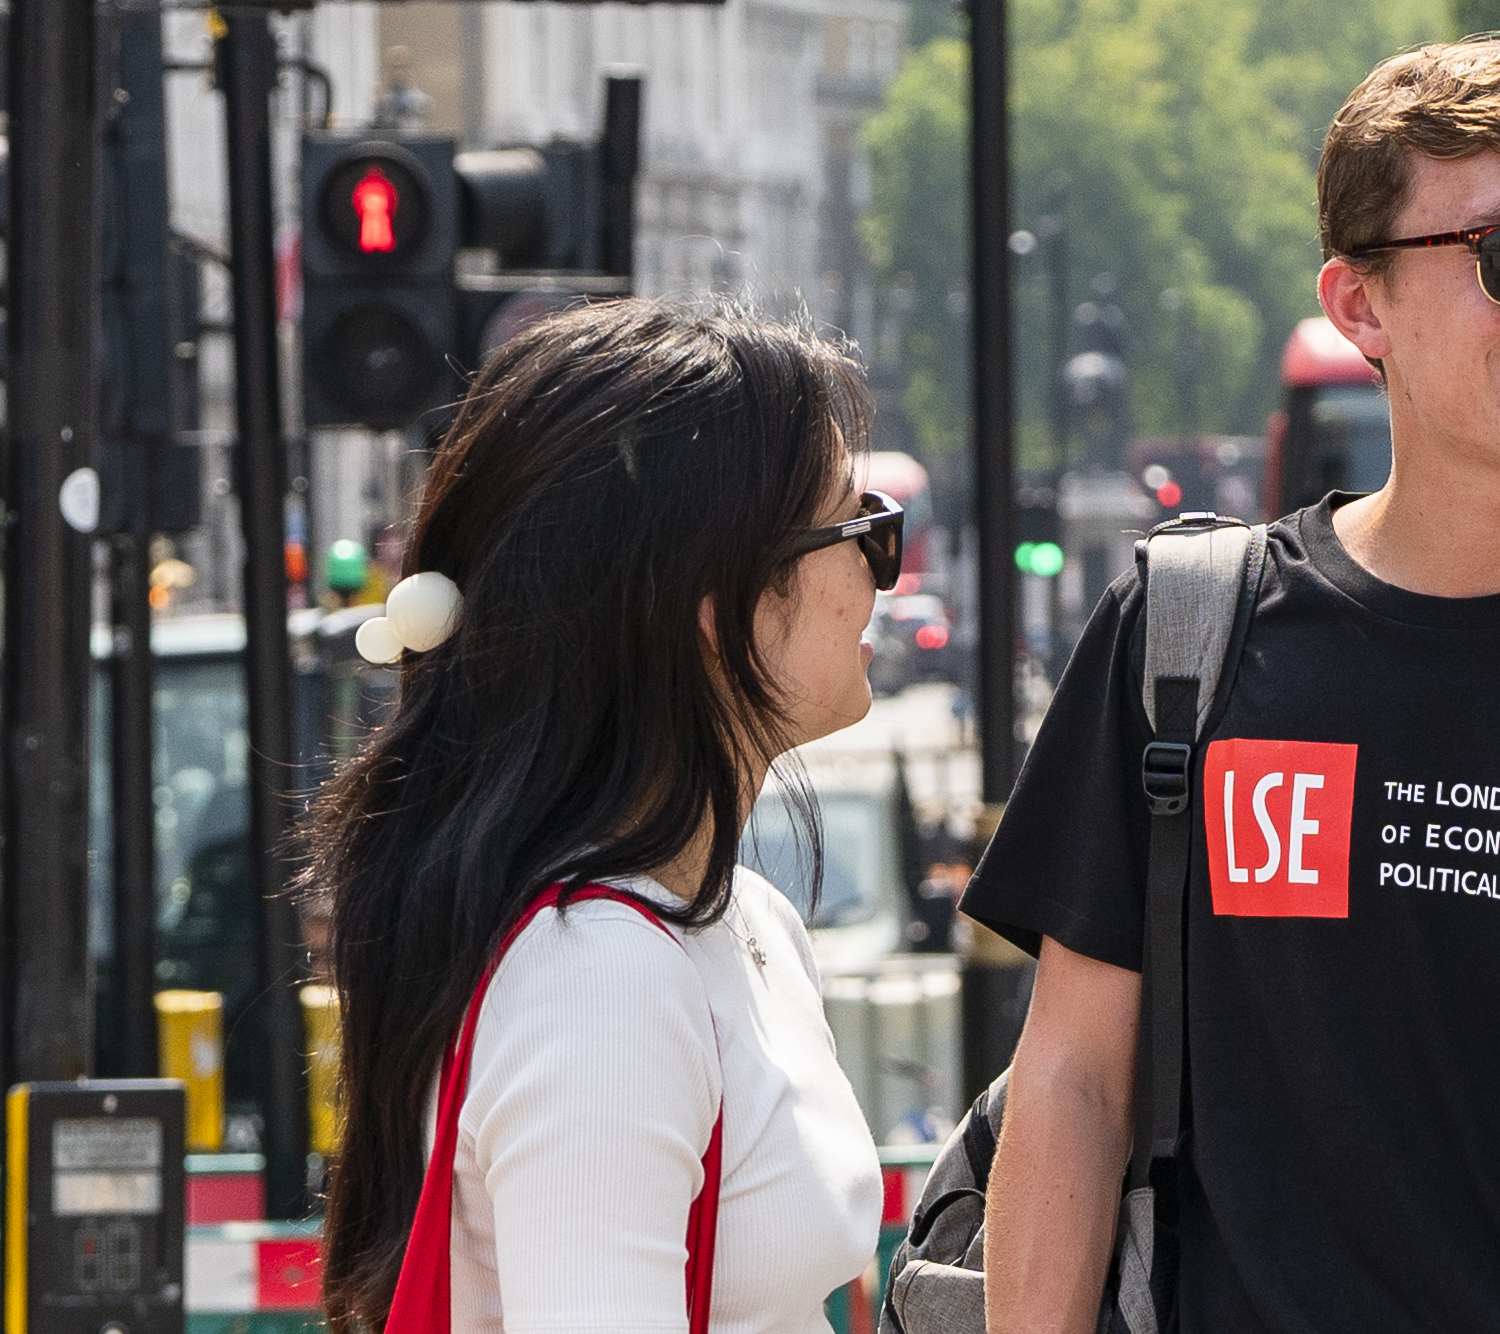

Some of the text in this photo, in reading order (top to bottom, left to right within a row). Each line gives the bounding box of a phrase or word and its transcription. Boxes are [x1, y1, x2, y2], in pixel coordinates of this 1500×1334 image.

[1384, 781, 1426, 803] THE
[1223, 770, 1325, 884] LSE
[1381, 824, 1411, 844] OF
